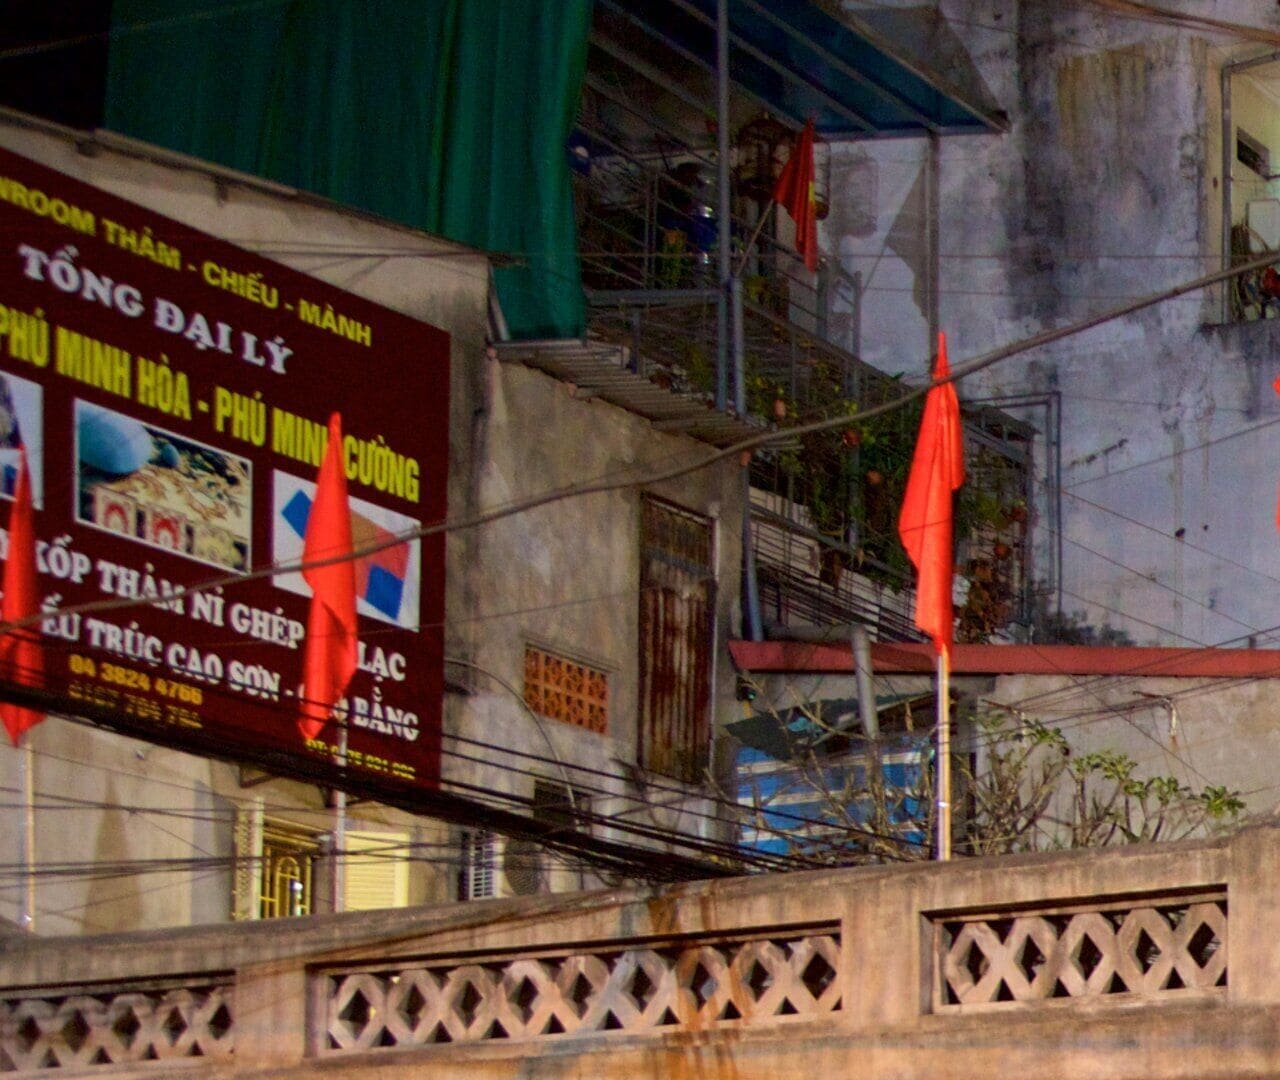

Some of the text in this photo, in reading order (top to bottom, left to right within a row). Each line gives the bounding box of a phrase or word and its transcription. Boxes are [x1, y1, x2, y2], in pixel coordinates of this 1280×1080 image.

[18, 244, 294, 375] TỔNG ĐẠI LÝ
[203, 260, 279, 309] CHIẾU
[299, 298, 371, 346] MÀNH
[56, 325, 131, 399] MINH
[137, 352, 192, 421] HÒA
[343, 434, 420, 503] CƯỜNG
[167, 642, 224, 684] CAO
[228, 660, 281, 701] SƠN
